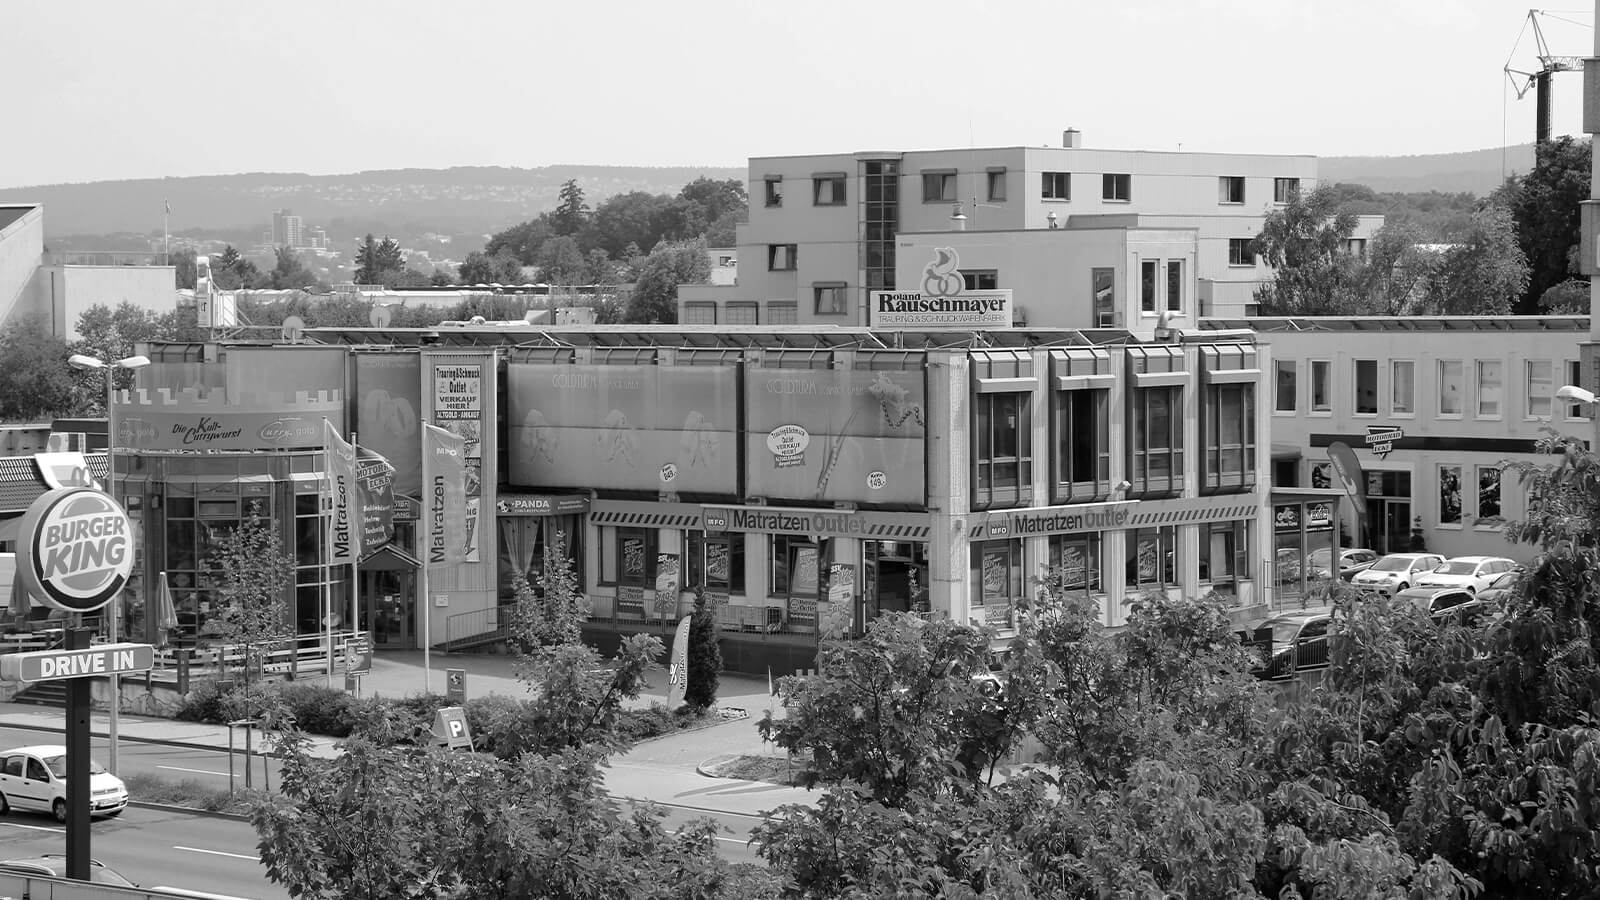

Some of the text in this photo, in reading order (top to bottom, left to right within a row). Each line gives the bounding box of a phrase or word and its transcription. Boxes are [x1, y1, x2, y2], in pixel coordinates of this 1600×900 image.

[878, 293, 1006, 314] Rauschmayer
[449, 381, 466, 393] Outlet
[172, 424, 186, 434] Die
[183, 427, 242, 444] Currywurst
[514, 500, 550, 508] PANDA
[334, 475, 350, 558] Matratzen
[430, 475, 445, 563] Matratzen
[733, 510, 867, 534] Matratzen Outlet
[1015, 508, 1129, 534] Matratzen Outlet
[46, 516, 125, 548] BURGER
[42, 536, 126, 580] KING
[40, 651, 135, 678] DRIVE IN
[449, 720, 462, 737] P
